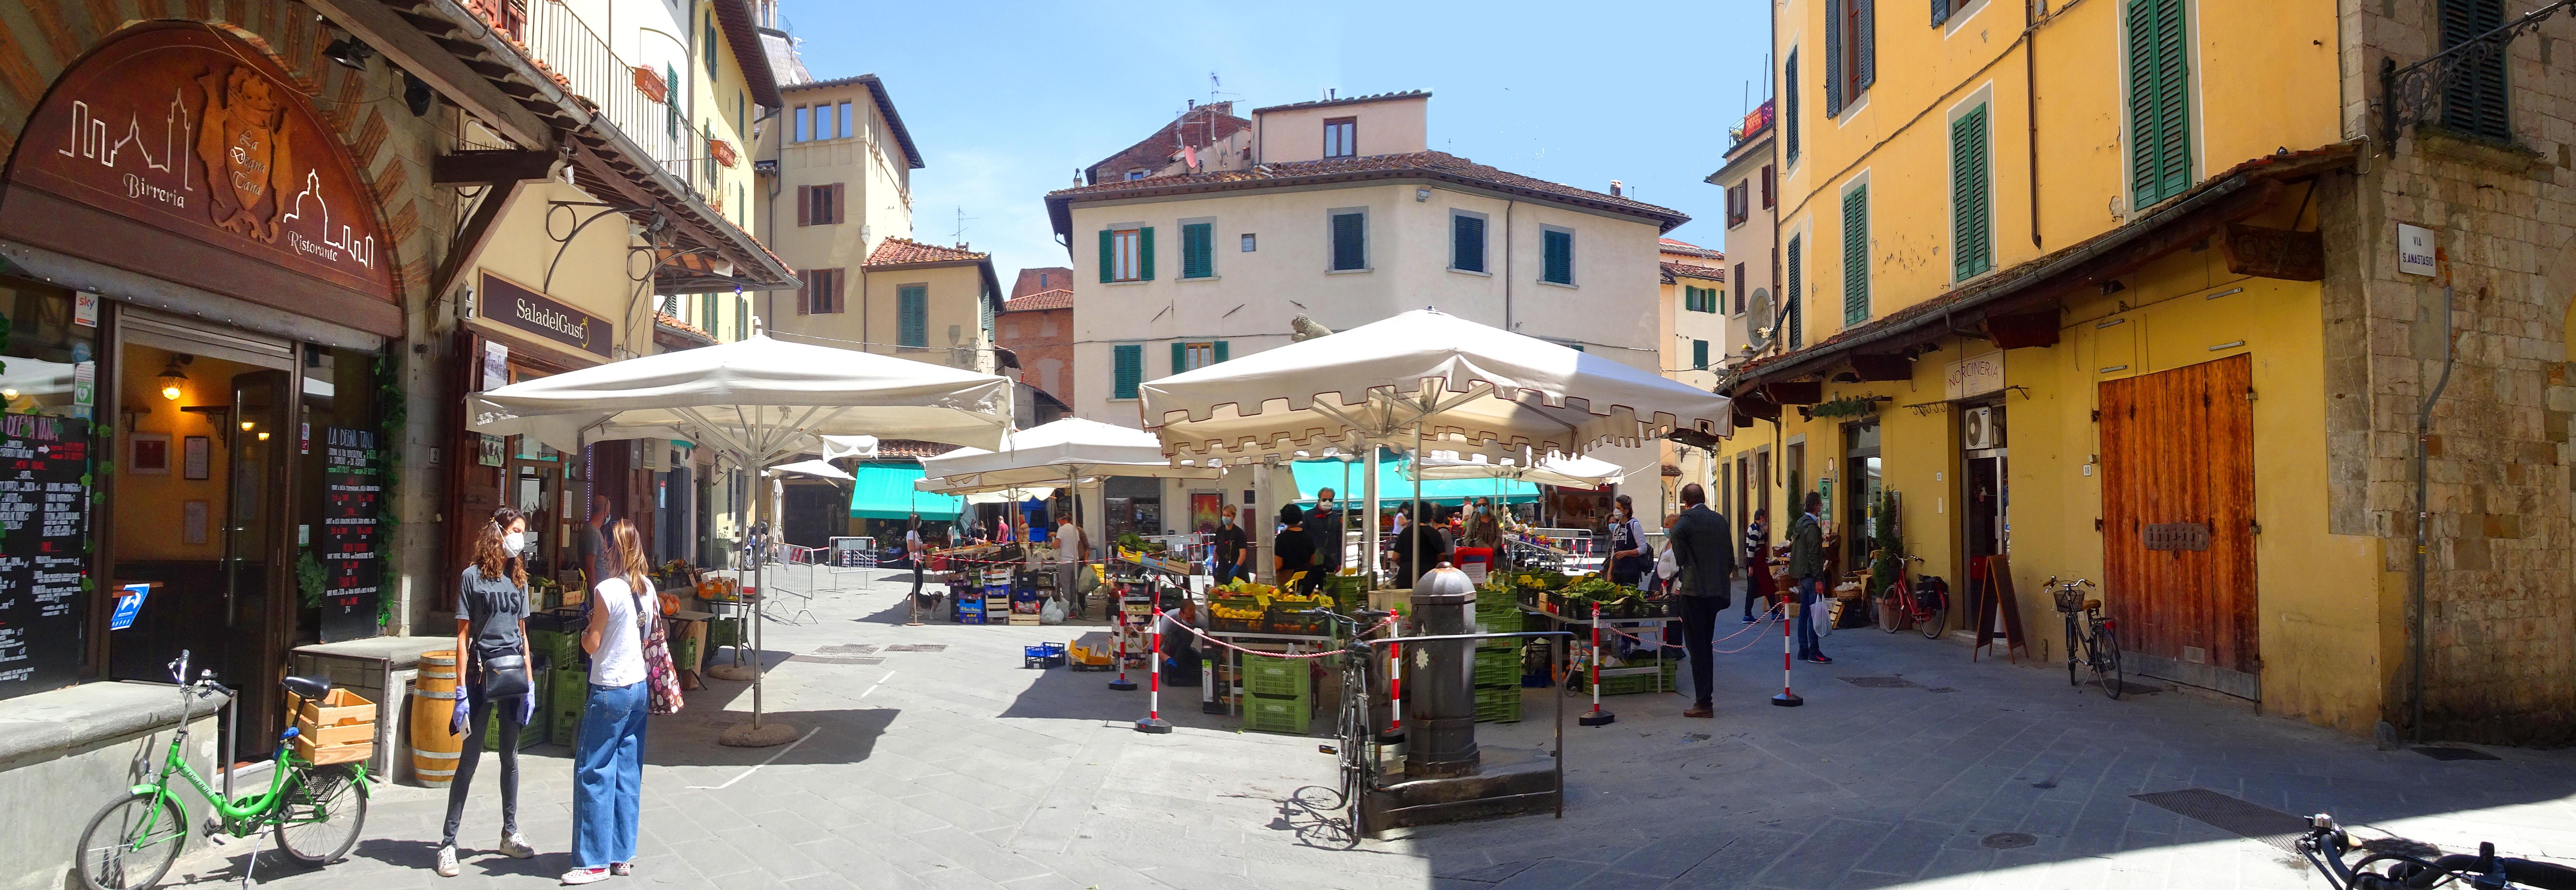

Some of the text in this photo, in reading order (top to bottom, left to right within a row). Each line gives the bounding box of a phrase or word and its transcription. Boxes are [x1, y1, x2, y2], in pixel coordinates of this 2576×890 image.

[240, 130, 259, 151] La
[230, 146, 266, 174] Degna
[124, 173, 185, 208] Birreria
[288, 231, 338, 262] Ristorante
[2413, 236, 2422, 247] VIA
[2403, 253, 2433, 266] S.ANASTASIO
[79, 296, 95, 310] sky
[1949, 361, 1998, 390] NORCINERIA
[328, 427, 373, 449] LA DEGNA TANA
[434, 450, 437, 461] 2
